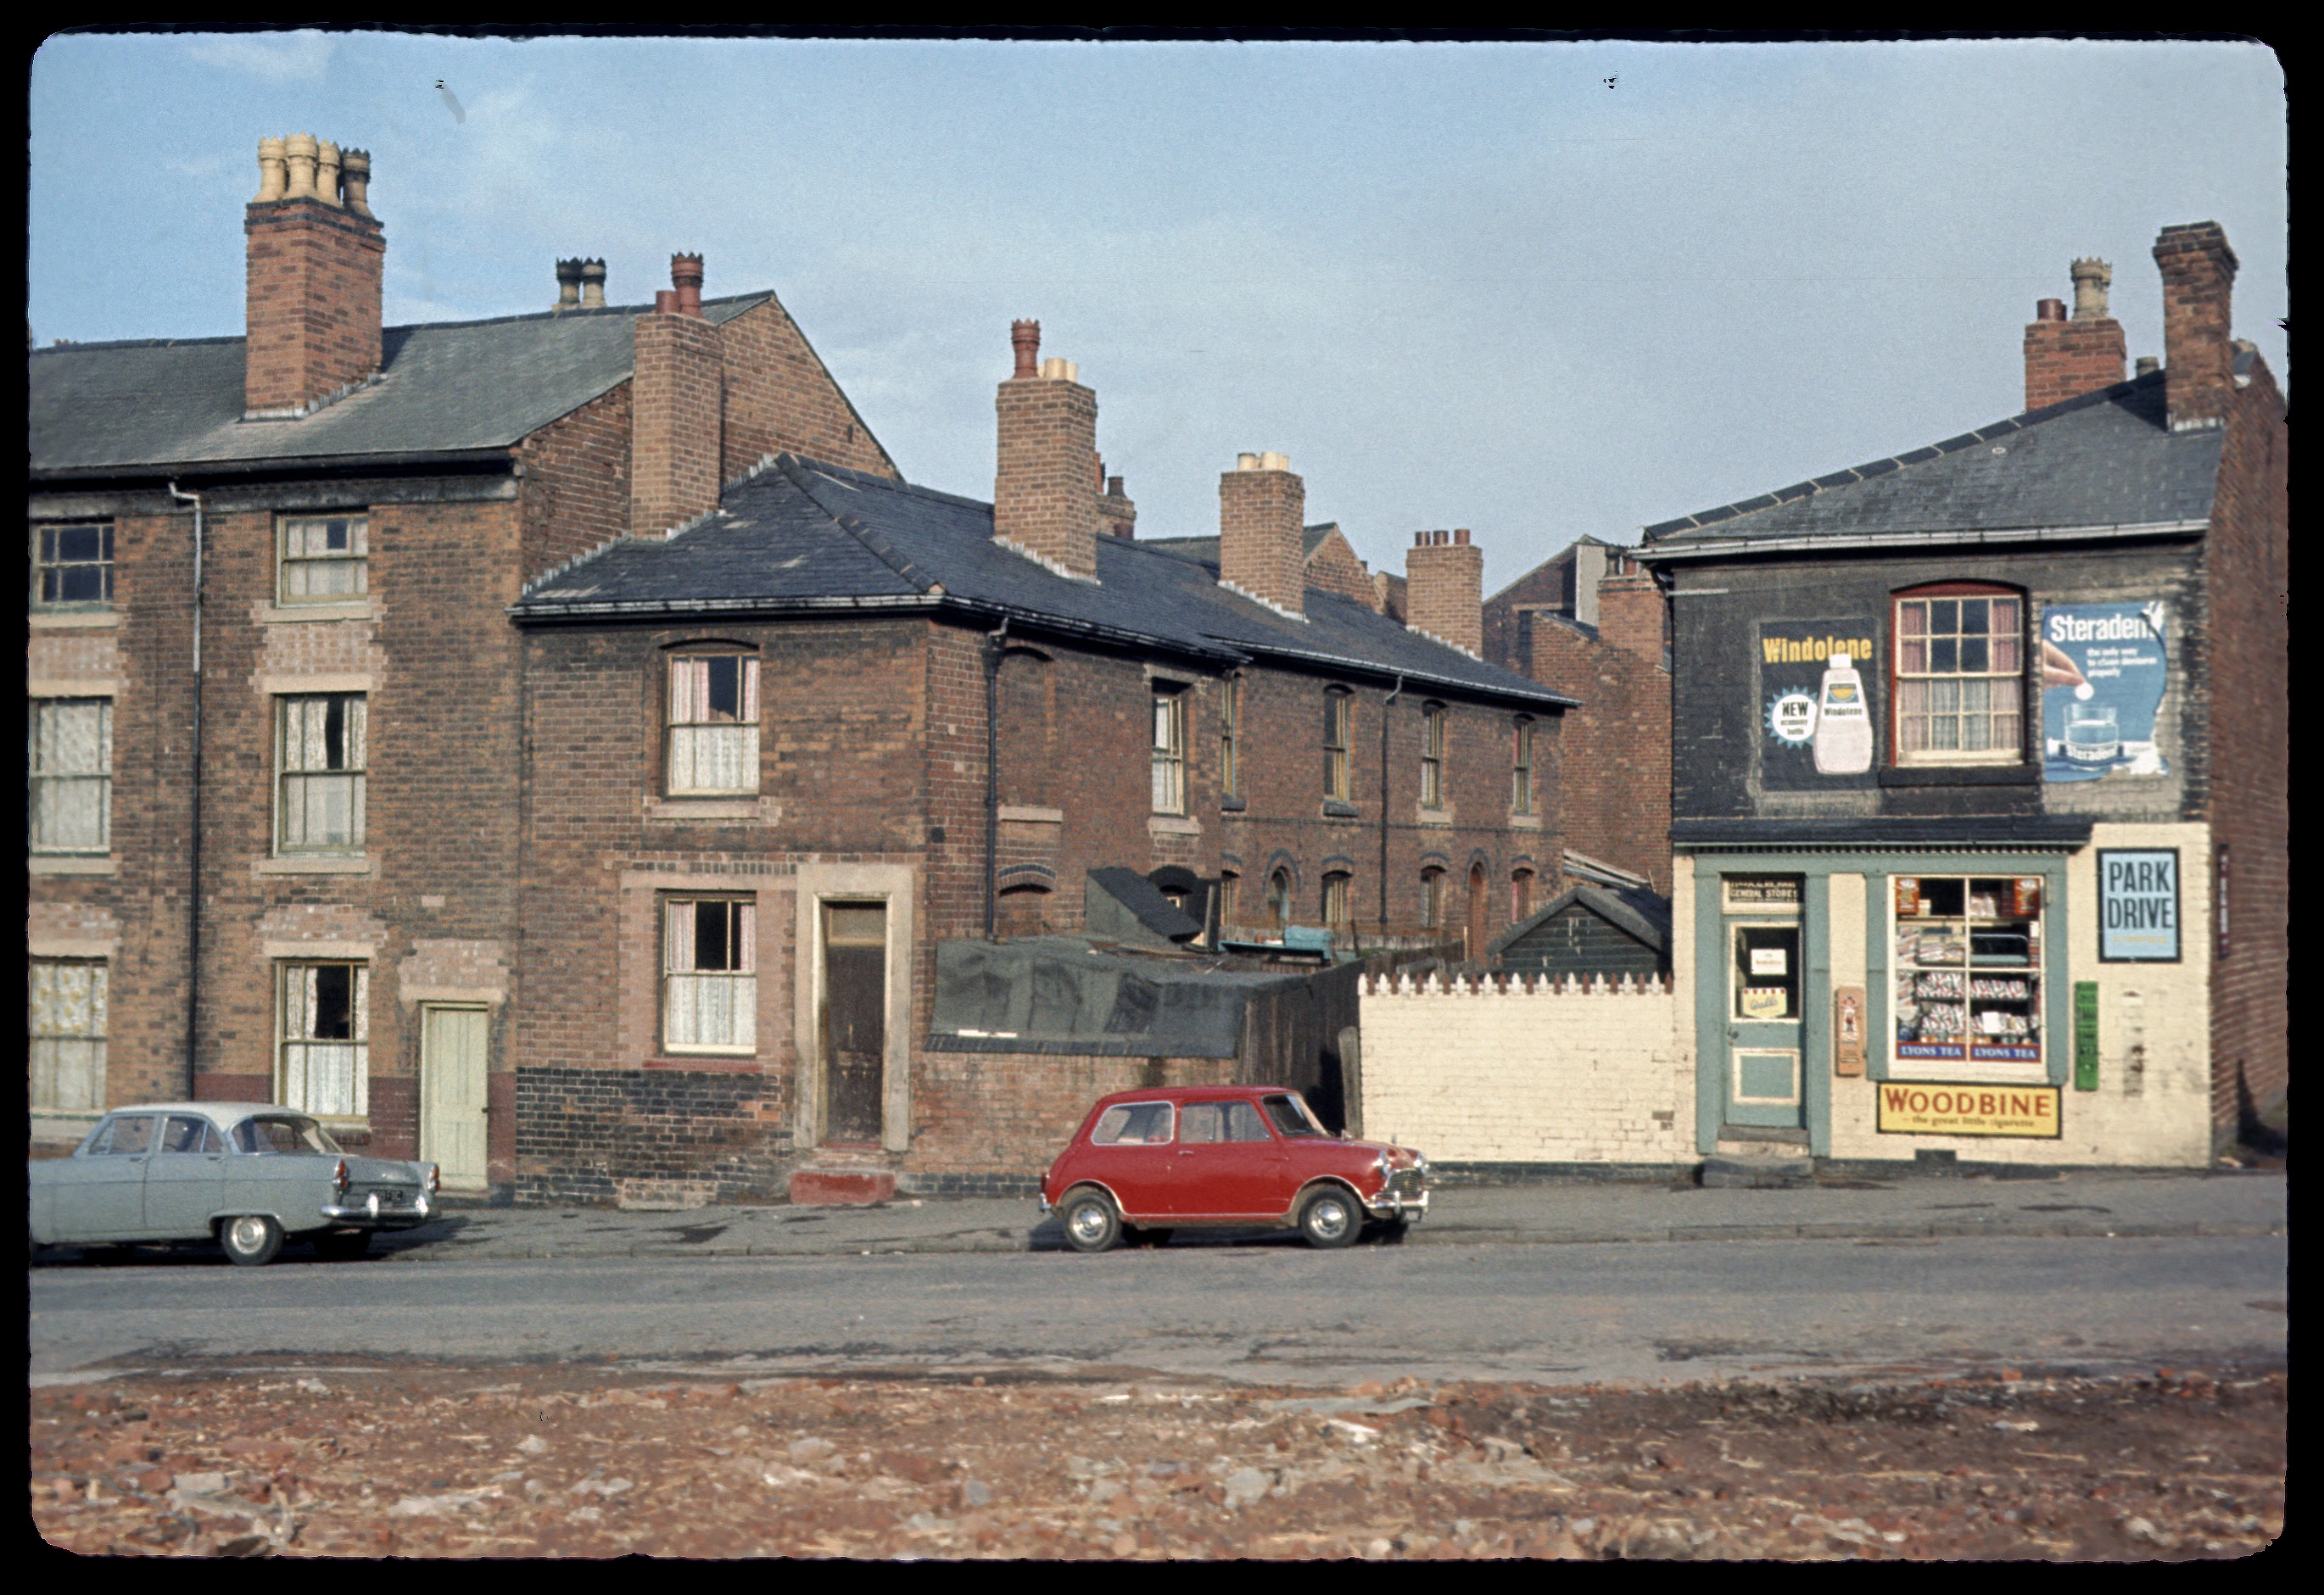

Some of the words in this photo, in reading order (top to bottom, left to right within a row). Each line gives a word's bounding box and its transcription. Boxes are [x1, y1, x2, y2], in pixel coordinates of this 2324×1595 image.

[1763, 636, 1873, 663] Windolene
[1782, 702, 1808, 717] NEW
[1824, 707, 1863, 717] Windolene
[2109, 861, 2171, 893] PARK
[1766, 889, 1797, 898] STORES
[2108, 897, 2174, 929] DRIVE
[1901, 1046, 1936, 1057] LYONS
[1941, 1046, 1962, 1057] TEA
[1975, 1047, 2010, 1058] LYONS
[2015, 1048, 2036, 1059] TEA
[1885, 1088, 2051, 1118] WOODBINE
[1912, 1116, 1927, 1124] the
[1931, 1117, 1958, 1127] great
[1962, 1117, 1986, 1125] little
